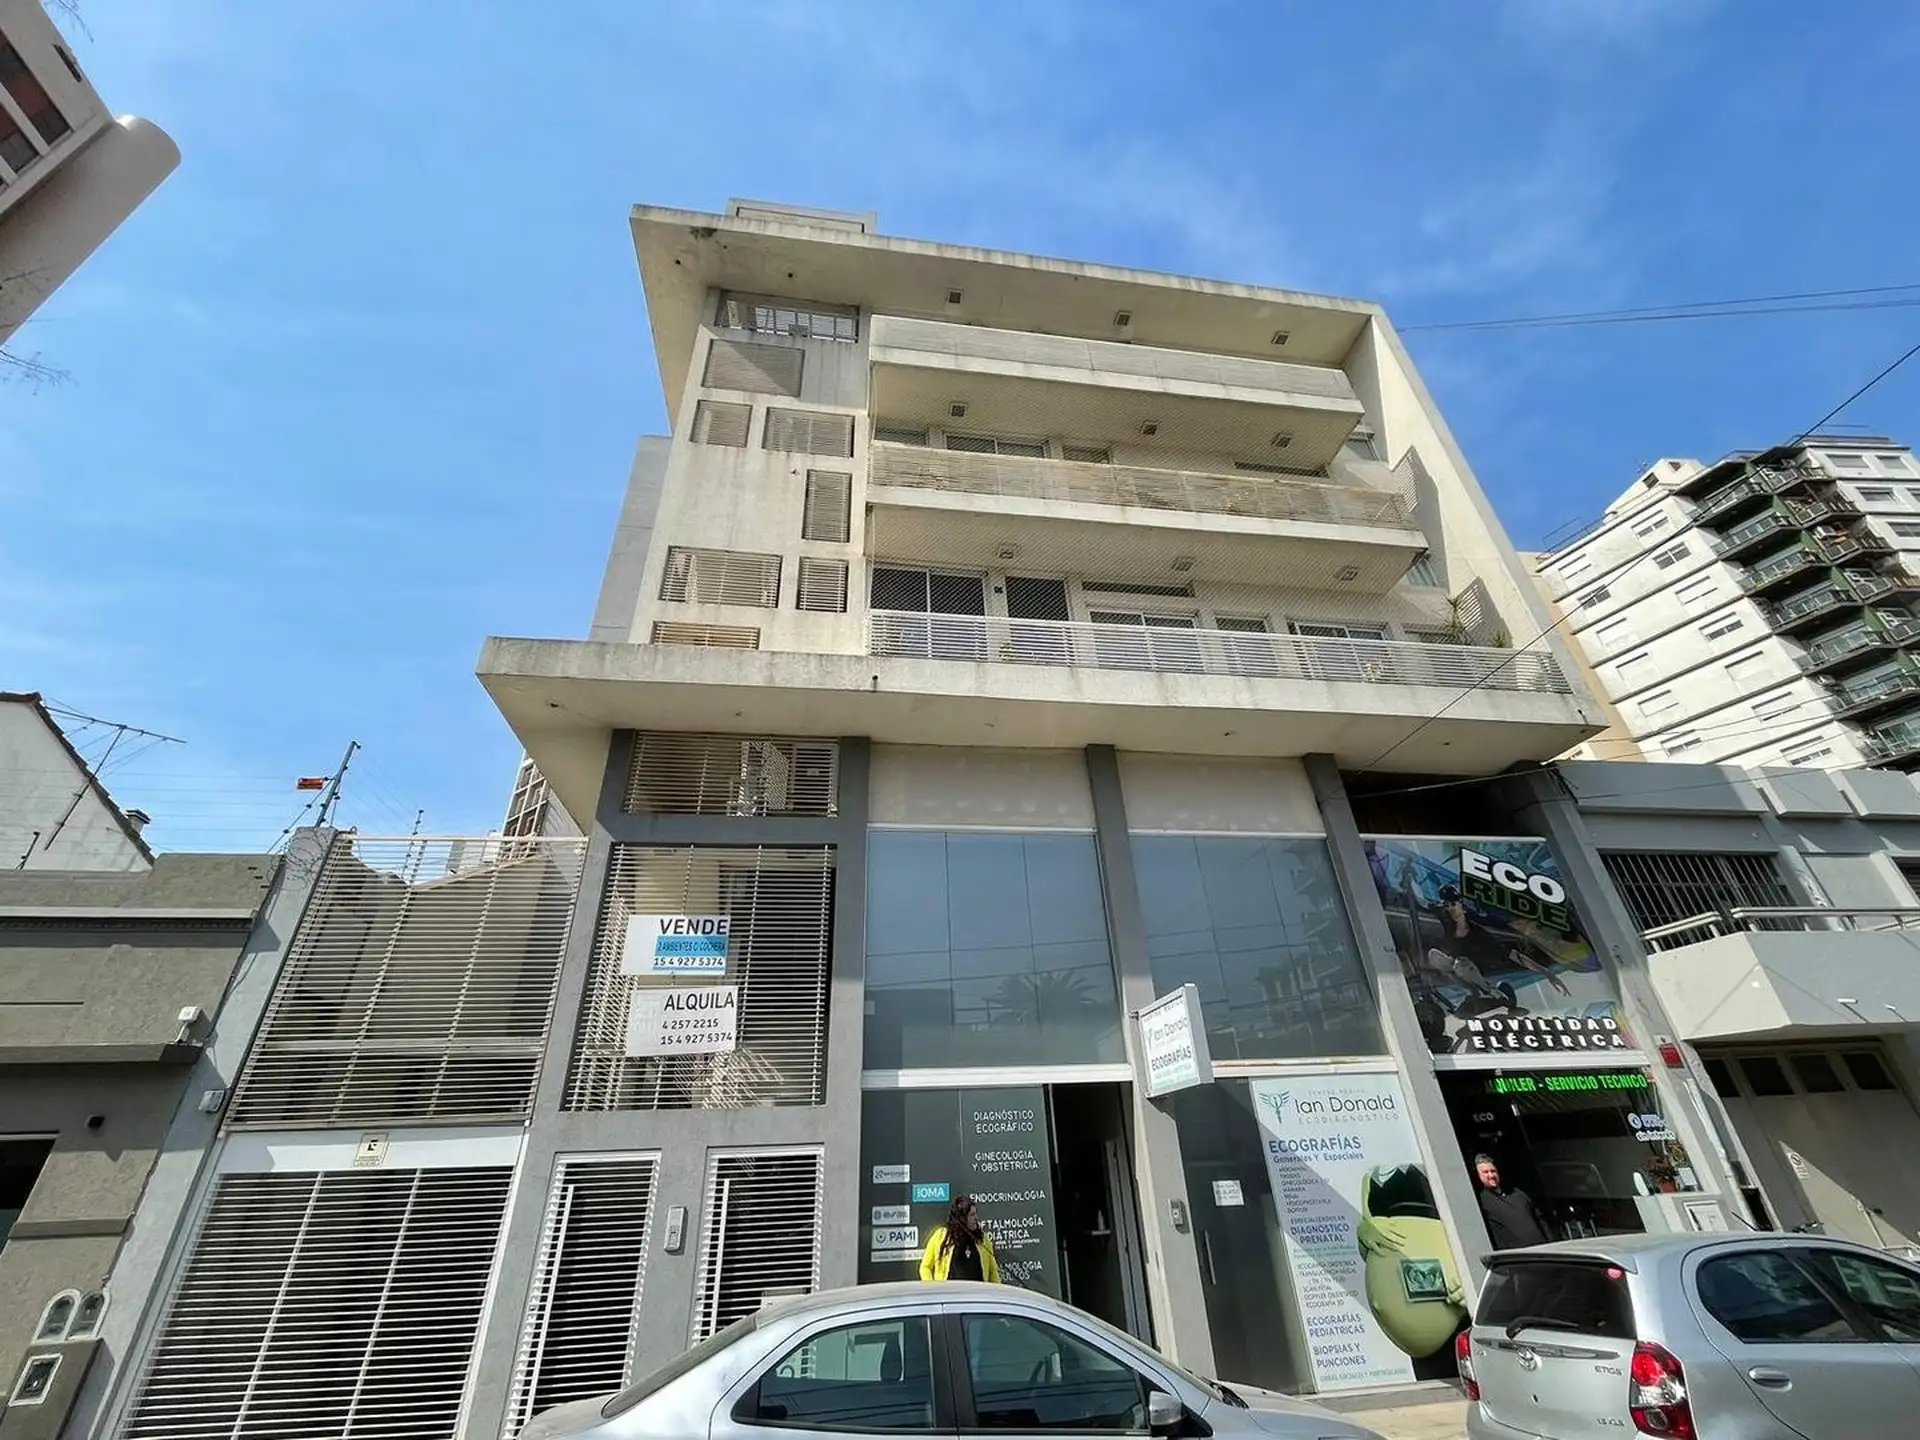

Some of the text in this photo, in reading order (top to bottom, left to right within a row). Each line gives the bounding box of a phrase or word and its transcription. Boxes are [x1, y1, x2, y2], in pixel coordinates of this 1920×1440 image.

[1461, 847, 1566, 904] ECO
[1462, 872, 1571, 932] RIDE
[660, 919, 728, 935] VENDE
[654, 957, 723, 966] 15 4 927 5374
[664, 992, 734, 1011] ALQUILA
[662, 1018, 719, 1030] 4 257 2215
[1466, 1017, 1618, 1032] MOVILIDAD
[661, 1032, 733, 1045] 15 4 927 5374
[1473, 1031, 1625, 1049] ELÉCTRICA
[1544, 1075, 1598, 1090] SERVICIO
[1599, 1073, 1648, 1088] TECNICO
[1295, 1095, 1395, 1114] Ian Donald
[973, 1109, 1034, 1121] DIAGNÓSTICO
[976, 1121, 1034, 1133] ECOGRÁFICO
[1269, 1133, 1362, 1153] ECOGRAFÍAS
[1323, 1151, 1364, 1161] Especiales
[971, 1160, 1039, 1172] Y OBSTETRICIA
[917, 1187, 945, 1198] IOMA
[1290, 1223, 1350, 1235] DIAGNOSTICO
[889, 1231, 916, 1241] PAMI
[1300, 1233, 1345, 1244] PRENATAL
[1307, 1312, 1362, 1327] ECOGRAFÍAS
[1309, 1325, 1365, 1337] PEDIATRICAS
[1313, 1342, 1360, 1355] BIOPSIAS Y
[1316, 1355, 1366, 1368] PUNCIONES
